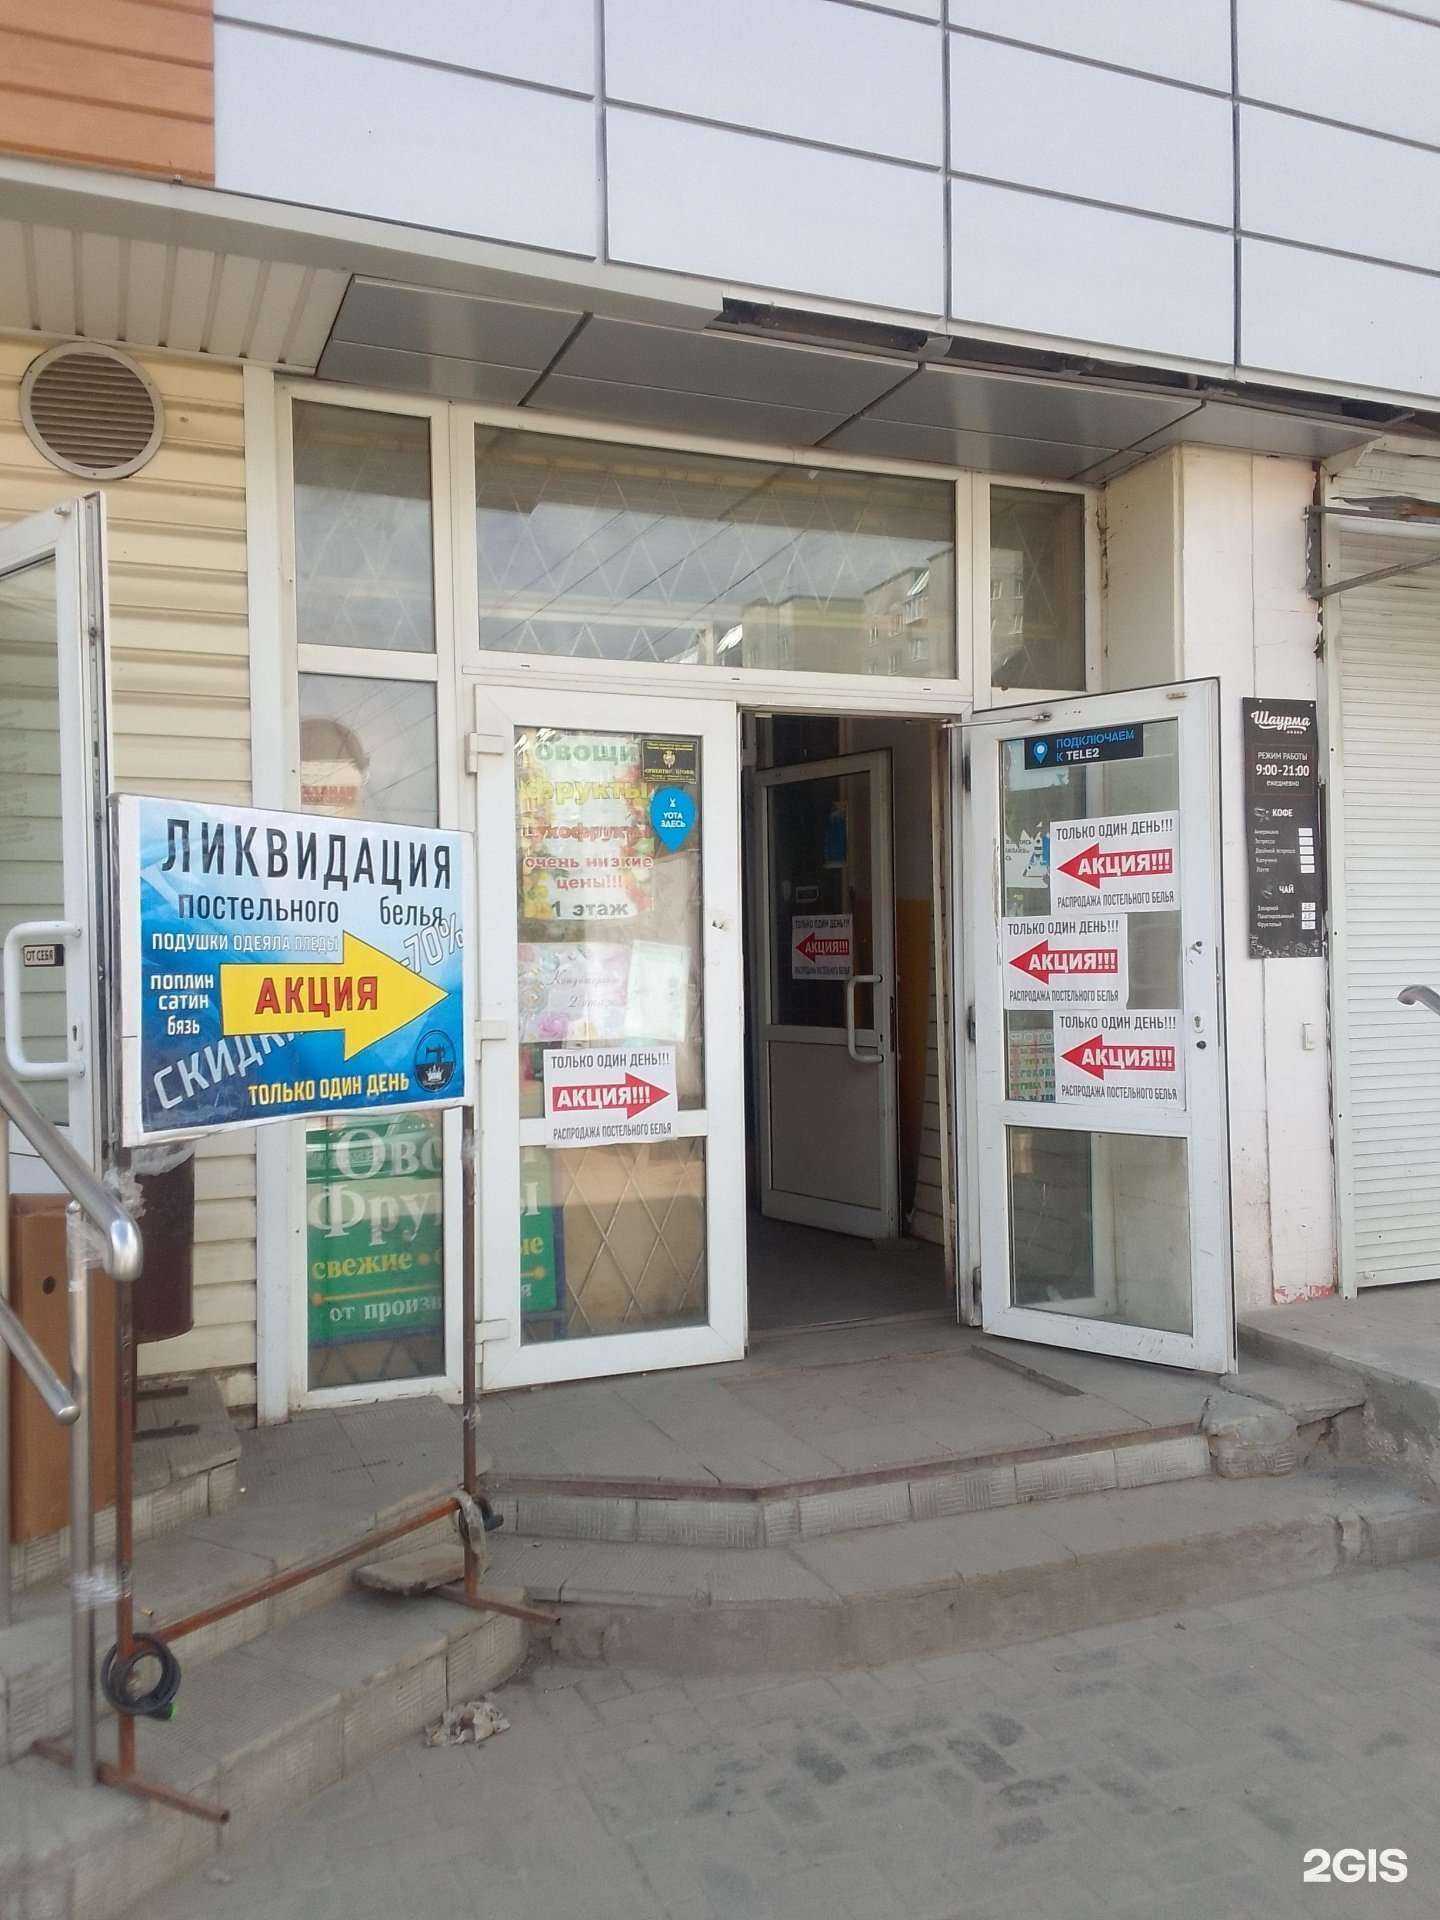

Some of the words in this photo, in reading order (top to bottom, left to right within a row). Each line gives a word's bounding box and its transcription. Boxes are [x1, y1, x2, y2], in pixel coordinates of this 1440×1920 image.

[1251, 710, 1311, 731] Шаурма
[1056, 729, 1136, 749] ПОДКЛЮЧАЕМ
[1056, 752, 1064, 762] К
[1066, 748, 1100, 760] TELE2
[1257, 752, 1281, 760] РЕЖИМ
[1283, 752, 1308, 760] РАБОТЫ
[1256, 764, 1310, 776] 9:00-21:00
[663, 811, 683, 820] YOTA
[1272, 808, 1293, 817] КОФЕ
[660, 820, 686, 828] ЗДЕСЬ
[1056, 826, 1095, 840] ТОЛЬКО
[1099, 823, 1128, 838] ОДИН
[1131, 818, 1173, 835] ДЕНЬ!!!
[162, 818, 450, 894] ЛИКВИДАЦИЯ
[524, 858, 580, 869] очень
[586, 856, 653, 869] низкие
[1078, 852, 1170, 877] АКЦИЯ!!!
[1279, 884, 1294, 894] ЧАЙ
[1057, 895, 1100, 908] РАСПРОДАЖА
[1102, 893, 1151, 906] ПОСТЕЛЬНОГО
[1152, 890, 1174, 903] БЕЛЬЯ
[178, 894, 339, 923] постельного
[380, 896, 442, 927] белья
[552, 901, 561, 917] 1
[573, 902, 629, 917] этаж
[1008, 923, 1045, 936] ТОЛЬКО
[1048, 922, 1076, 935] ОДИН
[1079, 920, 1119, 934] ДЕНЬ!!!
[152, 933, 228, 952] ПОДУШКИ
[233, 935, 289, 952] ОДЕЯЛА
[804, 940, 848, 954] АКЦИЯ!!!
[25, 950, 35, 961] ОТ
[1028, 952, 1116, 973] АКЦИЯ!!!
[150, 974, 214, 989] поплин
[158, 994, 209, 1010] сатин
[254, 976, 378, 1017] АКЦИЯ
[1009, 990, 1050, 1002] РАСПРОДАЖА
[1051, 990, 1095, 1002] ПОСТЕЛЬНОГО
[1096, 989, 1118, 1001] БЕЛЬЯ
[167, 1016, 200, 1036] бязь
[1059, 1016, 1098, 1029] ТОЛЬКО
[1102, 1016, 1131, 1030] ОДИН
[1134, 1016, 1176, 1030] ДЕНЬ!!!
[552, 1055, 594, 1069] ТОЛЬКО
[597, 1054, 627, 1069] ОДИН
[630, 1052, 670, 1067] ДЕНЬ!!!
[1082, 1048, 1173, 1070] АКЦИЯ!!!
[153, 1031, 304, 1110] СКИД
[248, 1082, 315, 1106] ТОЛЬКО
[320, 1075, 361, 1099] ОДИН
[367, 1072, 409, 1095] ДЕНЬ
[556, 1086, 651, 1109] АКЦИЯ!!!
[1061, 1084, 1104, 1099] РАСПРОДАЖА
[1106, 1085, 1153, 1100] ПОСТЕЛЬНОГО
[1155, 1087, 1177, 1100] БЕЛЬЯ
[553, 1127, 600, 1140] РАСПРОДАЖА
[602, 1125, 648, 1138] ПОСТЕЛЬНОГО
[650, 1122, 672, 1135] БЕЛЬЯ
[308, 1184, 442, 1246] Фру
[311, 1252, 413, 1280] свежие
[329, 1306, 354, 1322] от
